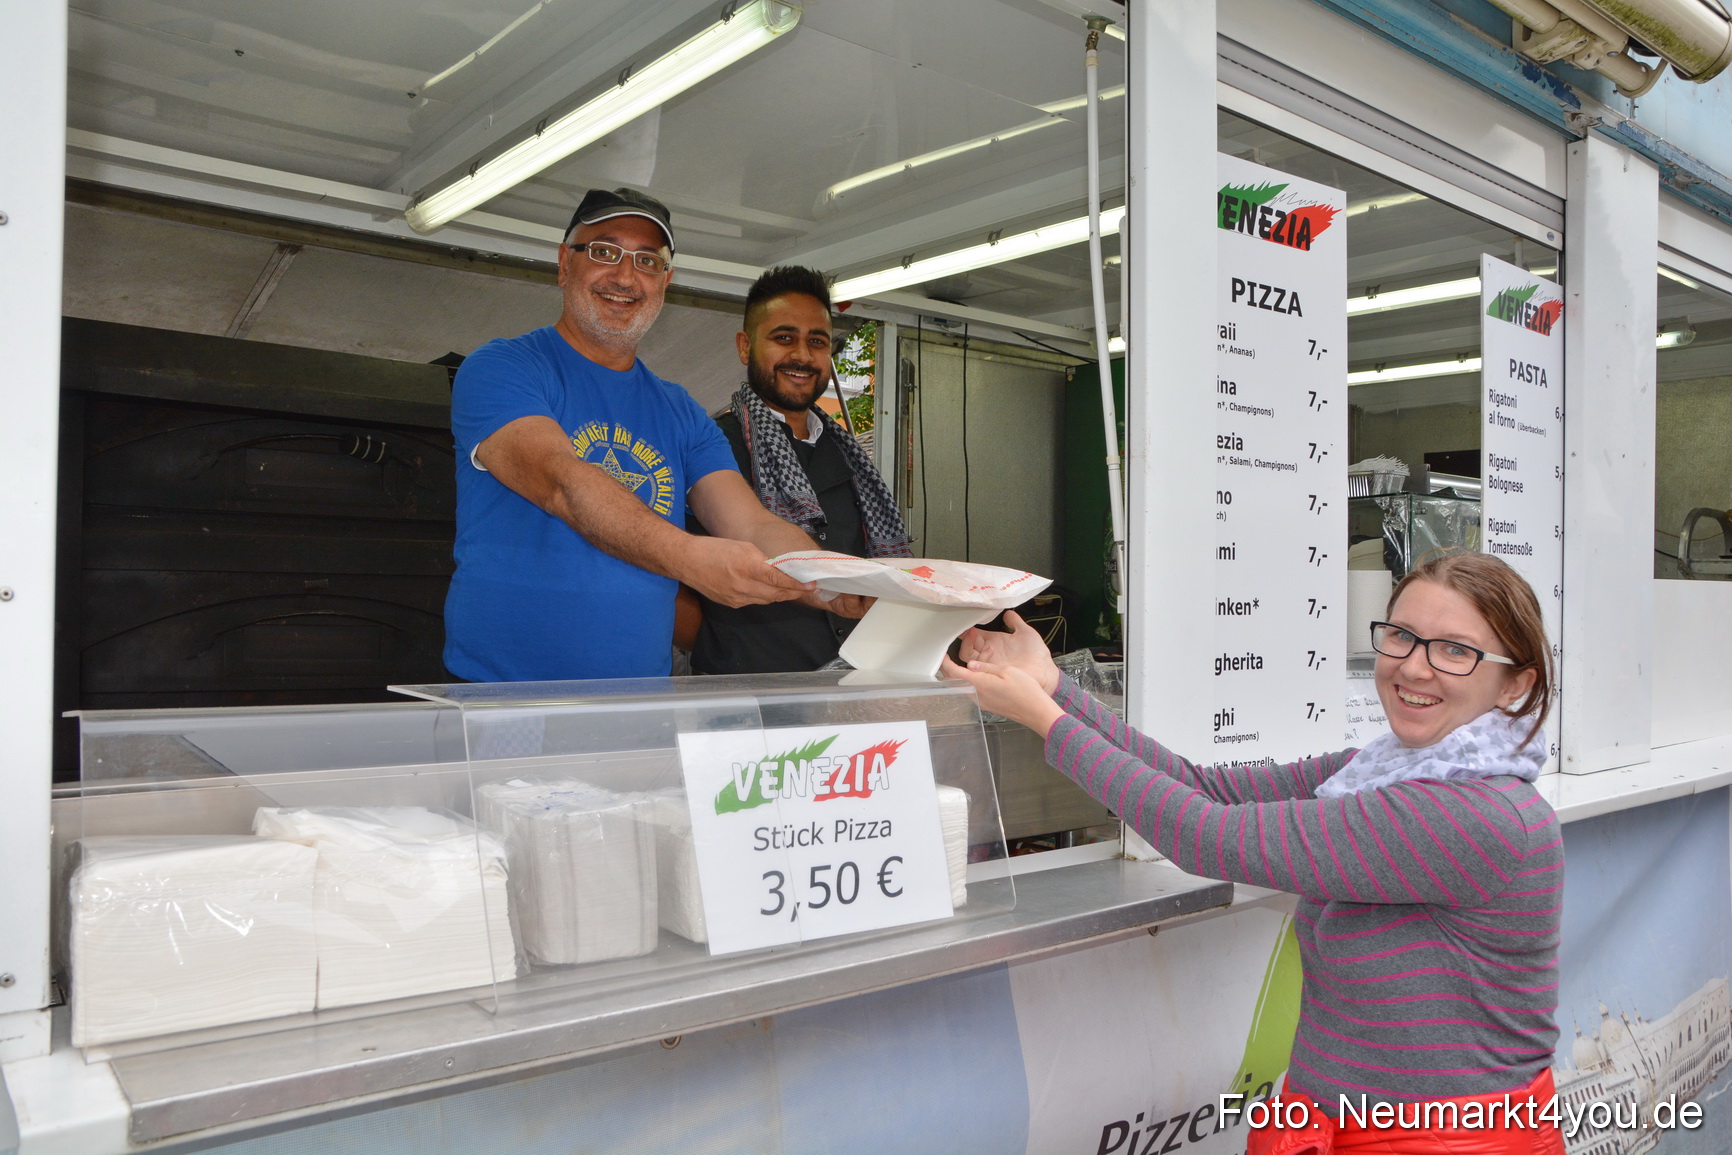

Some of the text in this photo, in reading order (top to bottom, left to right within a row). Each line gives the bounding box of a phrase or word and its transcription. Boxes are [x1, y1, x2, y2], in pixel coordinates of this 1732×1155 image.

[1231, 277, 1303, 317] PIZZA
[1498, 291, 1551, 336] VENEZIA
[1229, 345, 1256, 359] Ananas)
[1308, 339, 1328, 360] 7,-
[1509, 358, 1548, 388] PASTA
[1308, 391, 1328, 412] 7,-
[1488, 388, 1518, 408] Rigatoni
[1229, 402, 1275, 418] Champignons)
[1488, 410, 1547, 437] al forno (überbacken)
[1217, 432, 1328, 464] ezia 7,-
[1229, 456, 1253, 468] Salami,
[1254, 459, 1298, 473] Champignons)
[1488, 453, 1518, 471] Rigatoni
[631, 441, 662, 469] MORE
[653, 466, 672, 515] WEALTH
[1488, 475, 1524, 494] Bolognese
[1308, 495, 1328, 515] 7,-
[1488, 518, 1517, 535] Rigatoni
[1308, 547, 1328, 567] 7,-
[1488, 540, 1533, 556] Tomatensoße
[1308, 599, 1328, 618] 7,-
[1214, 651, 1327, 676] gherita 7,-
[1213, 708, 1235, 732] ghi
[1306, 703, 1326, 722] 7,-
[1213, 731, 1260, 744] Champignons)
[731, 752, 890, 802] VENEZIA
[753, 818, 892, 852] Stück Pizza
[760, 855, 904, 923] 3,50 €
